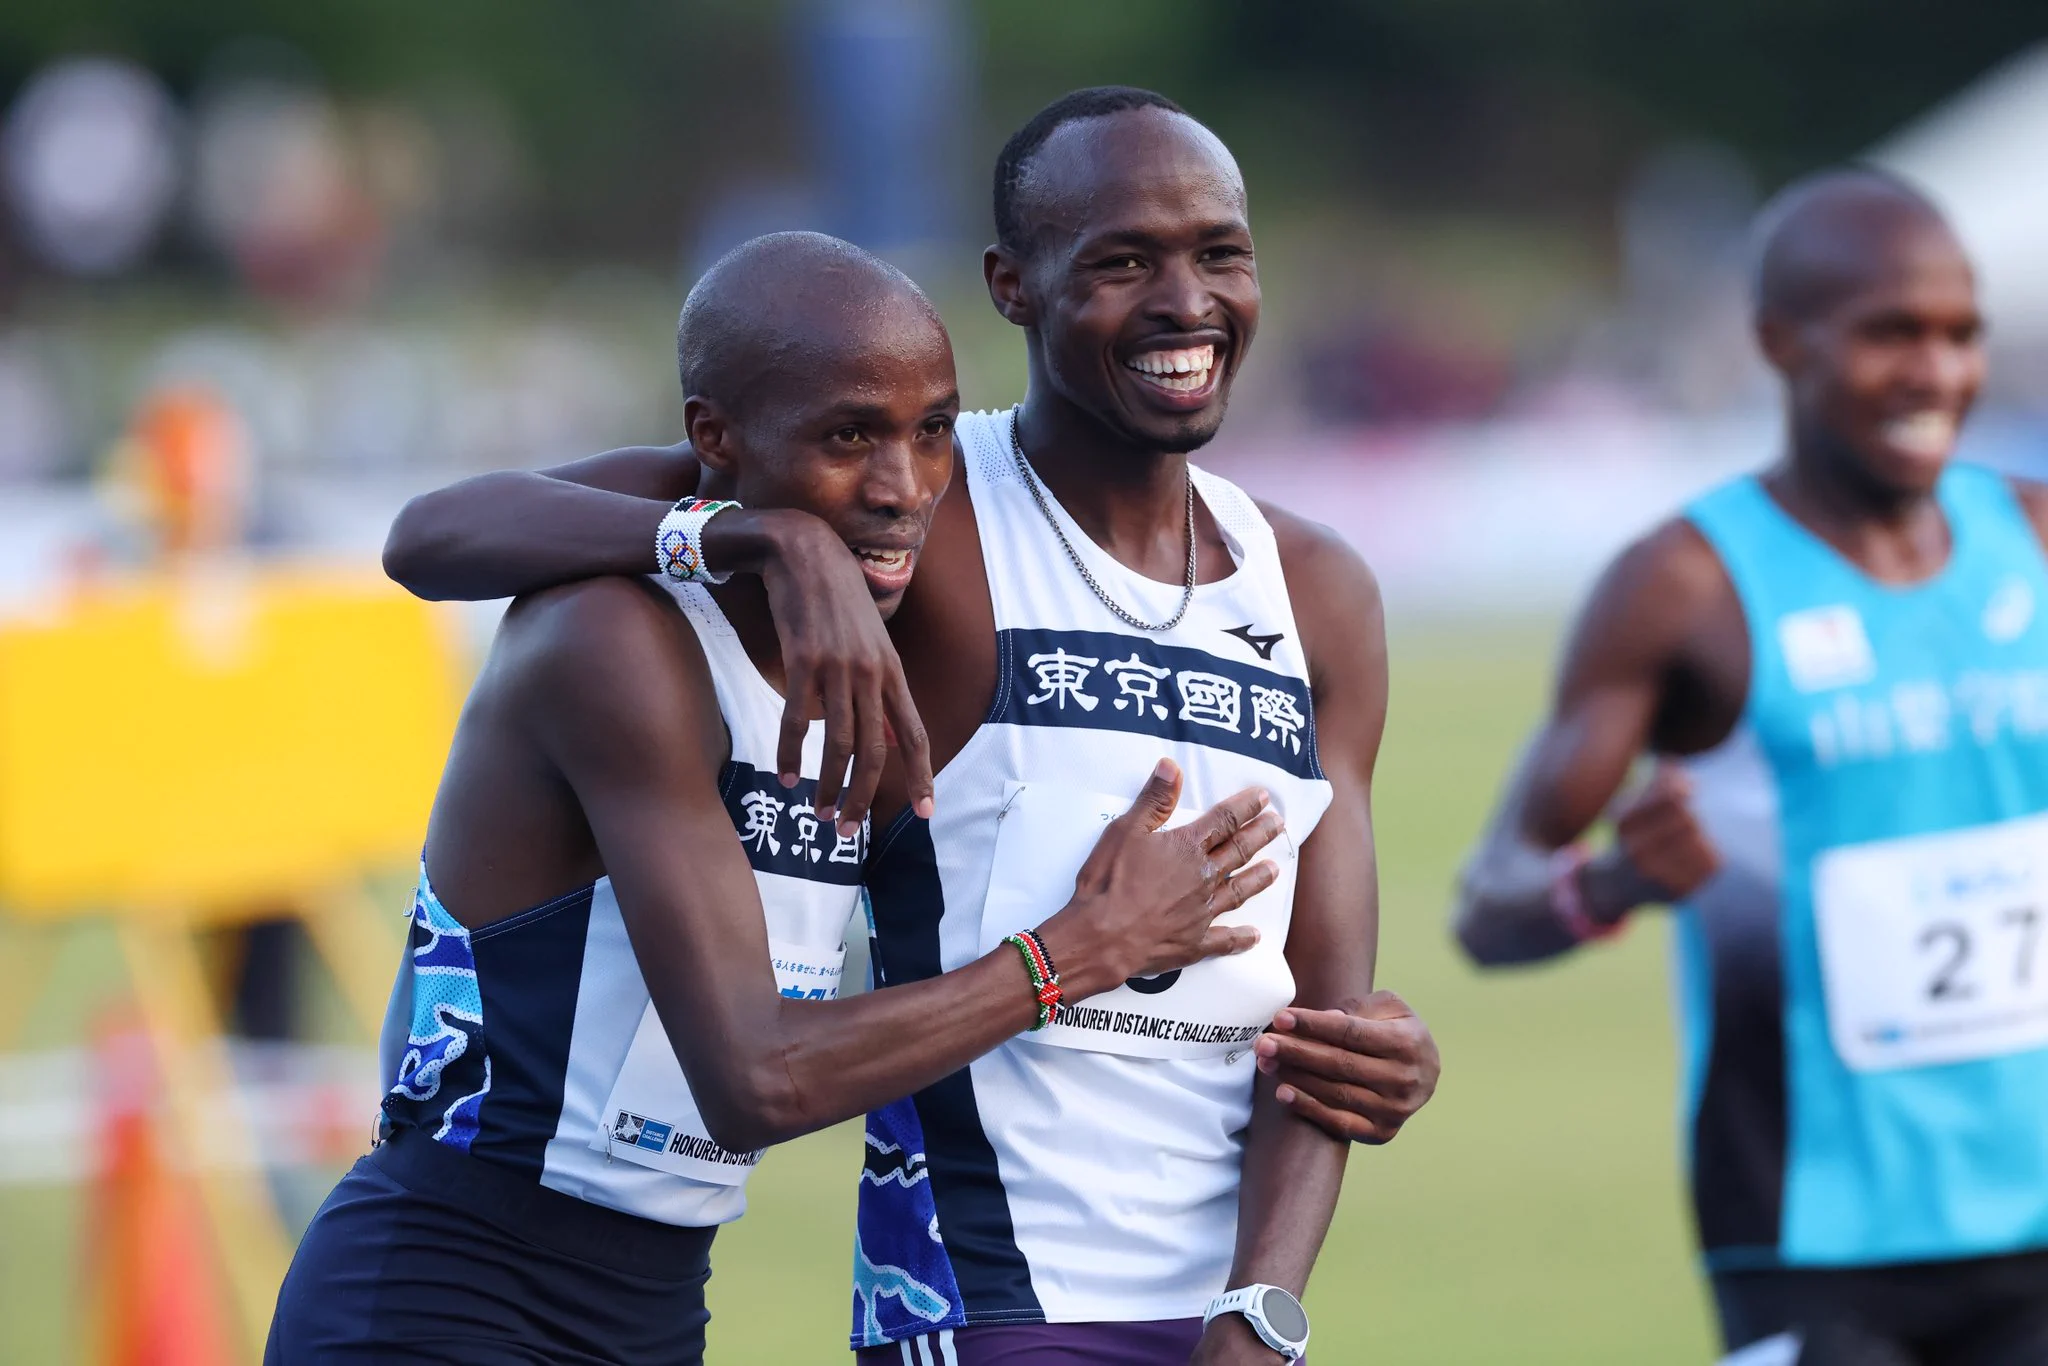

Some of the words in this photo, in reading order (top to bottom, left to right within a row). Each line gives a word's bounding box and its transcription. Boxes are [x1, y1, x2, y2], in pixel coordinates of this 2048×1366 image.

[1027, 648, 1305, 755] 東京國際
[1055, 1005, 1114, 1031] HOKUREN
[1113, 1012, 1175, 1040] DISTANCE
[1173, 1022, 1240, 1043] CHALLENGE
[669, 1132, 723, 1163] HOKUREN
